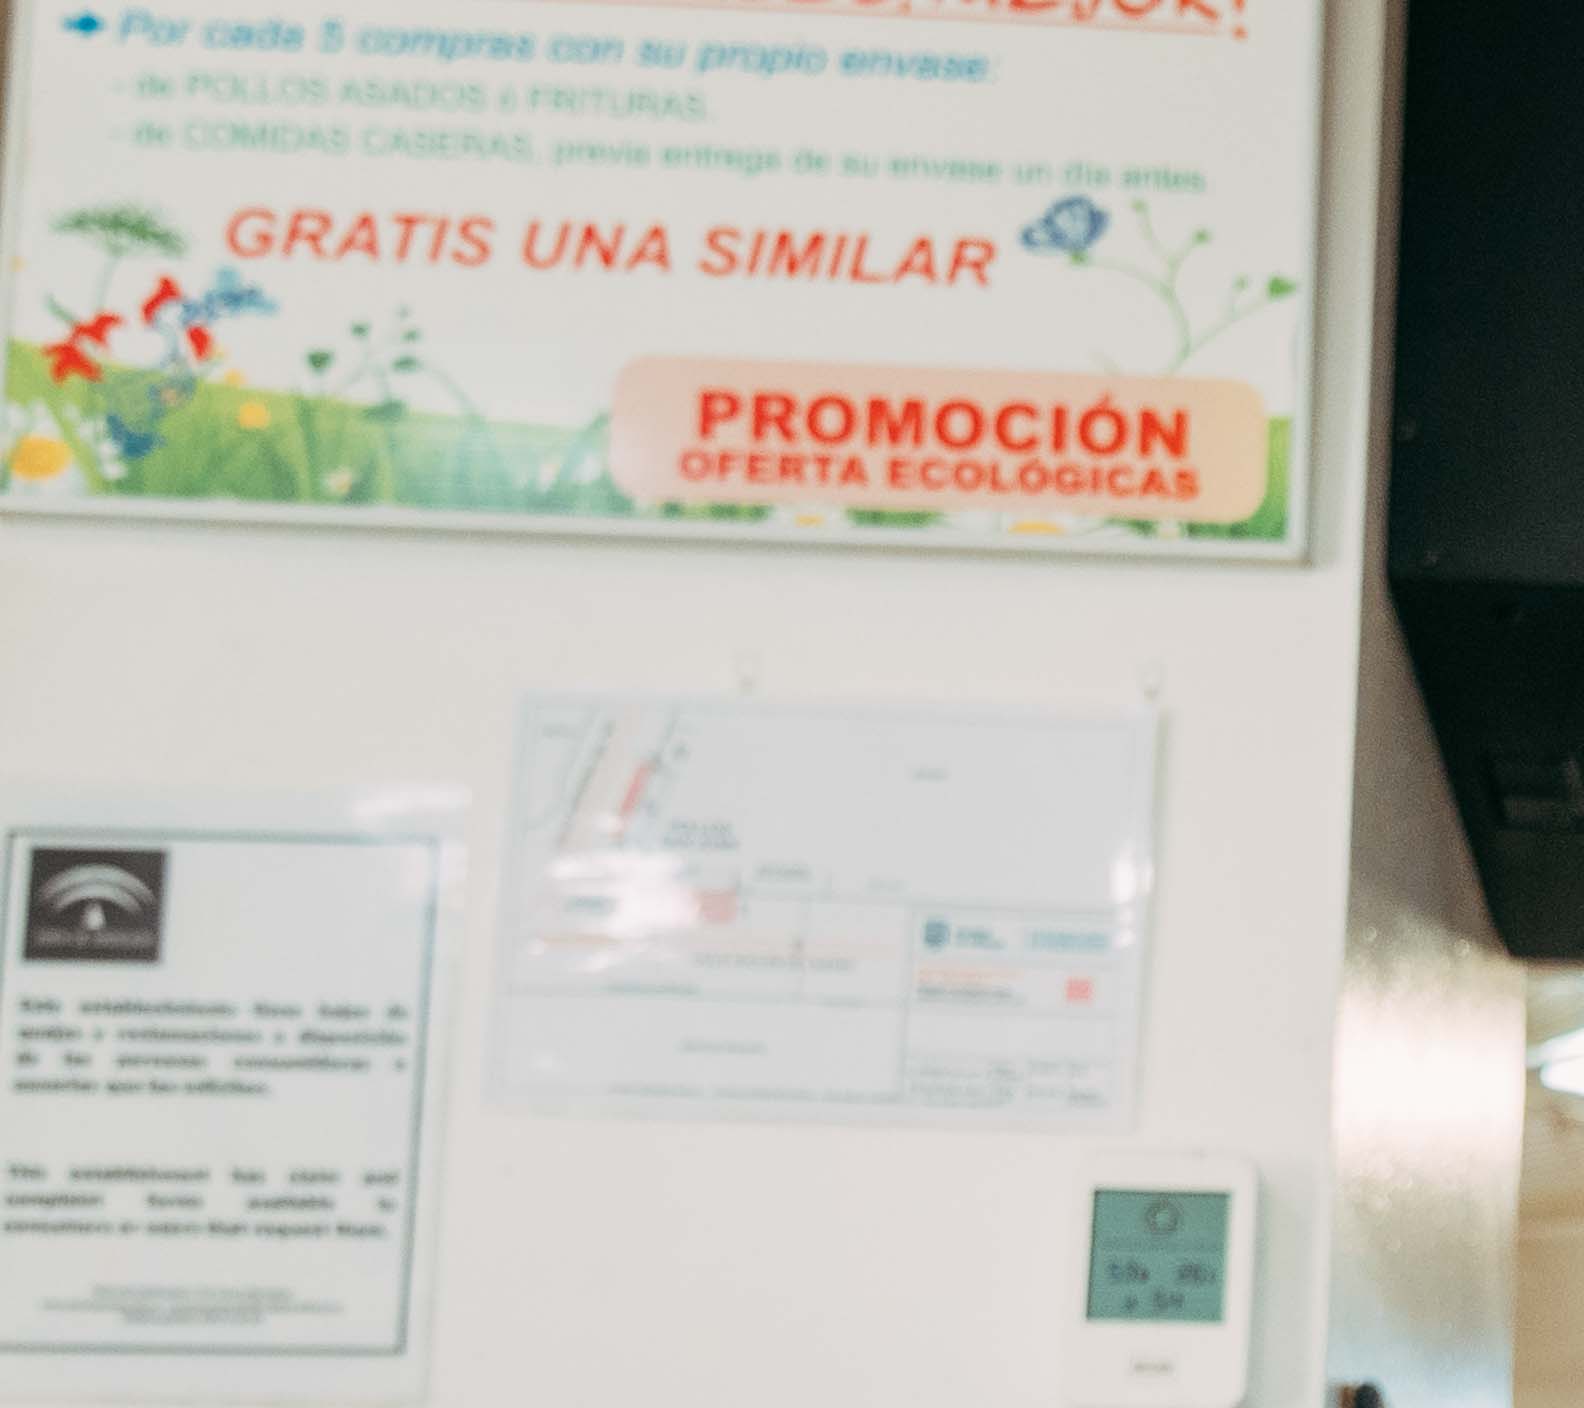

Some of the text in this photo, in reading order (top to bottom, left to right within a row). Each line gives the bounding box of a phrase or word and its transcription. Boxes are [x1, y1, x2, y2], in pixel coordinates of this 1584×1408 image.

[203, 17, 303, 52] cada
[358, 29, 534, 66] compras
[700, 41, 828, 78] propio
[224, 207, 998, 288] GRATIS UNA SIMILAR
[697, 388, 1190, 459] PROMOCIÓN
[678, 449, 1202, 501] OFERTA ECOLÓGICAS
